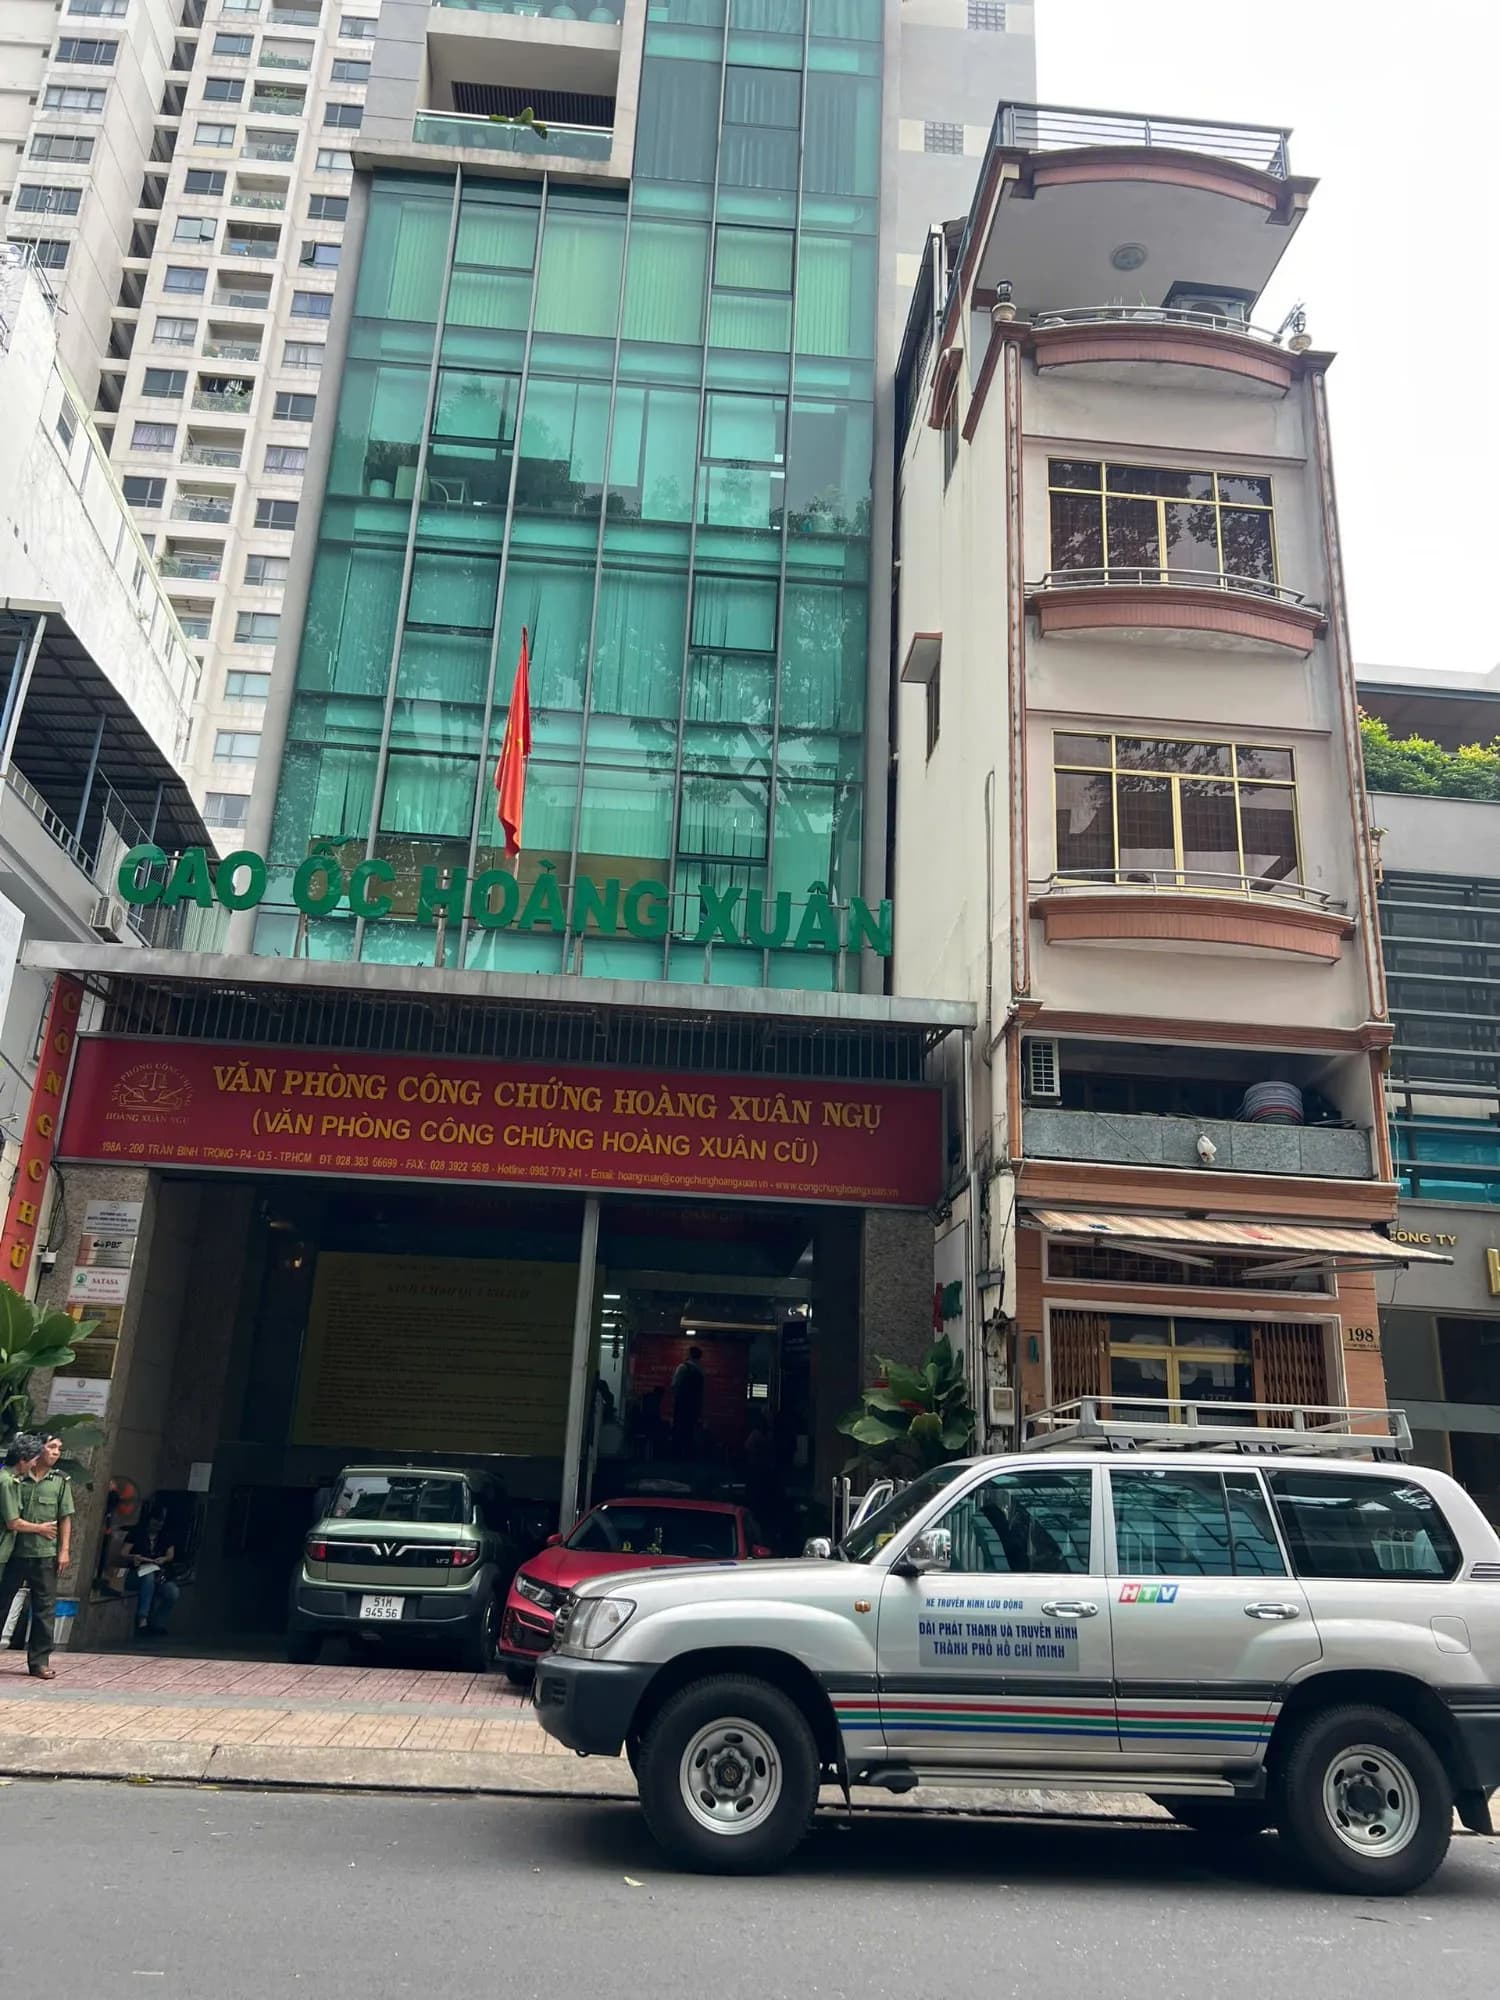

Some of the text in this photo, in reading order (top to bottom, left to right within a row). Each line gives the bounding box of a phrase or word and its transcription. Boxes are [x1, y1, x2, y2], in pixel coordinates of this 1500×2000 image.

[118, 835, 894, 957] CAO ỐC HOÀNG XUÂN
[37, 990, 79, 1141] CÔNG
[213, 1059, 277, 1094] VĂN
[281, 1063, 388, 1101] PHÒNG
[398, 1071, 482, 1106] CÔNG
[494, 1075, 603, 1113] CHỨNG
[612, 1084, 717, 1120] HOÀNG
[728, 1092, 813, 1125] XUÂN
[822, 1101, 882, 1136] NGỤ
[253, 1107, 819, 1168] (VĂN PHÒNG CÔNG CHỨNG HOÀNG XUÂN CŨ)
[102, 1141, 122, 1152] 198A
[129, 1143, 145, 1154] 200
[405, 1158, 428, 1170] FAX:
[497, 1163, 528, 1176] Hotline:
[568, 1168, 582, 1179] 241
[1436, 1233, 1457, 1246] TY
[1347, 1327, 1374, 1343] 198
[1120, 1584, 1178, 1602] HTV
[919, 1619, 1078, 1641] ĐÀI PHÁT THANH VÀ TRUYỀN HÌNH
[934, 1638, 1065, 1659] THÀNH PHỐ HỒ CHÍ MINH
